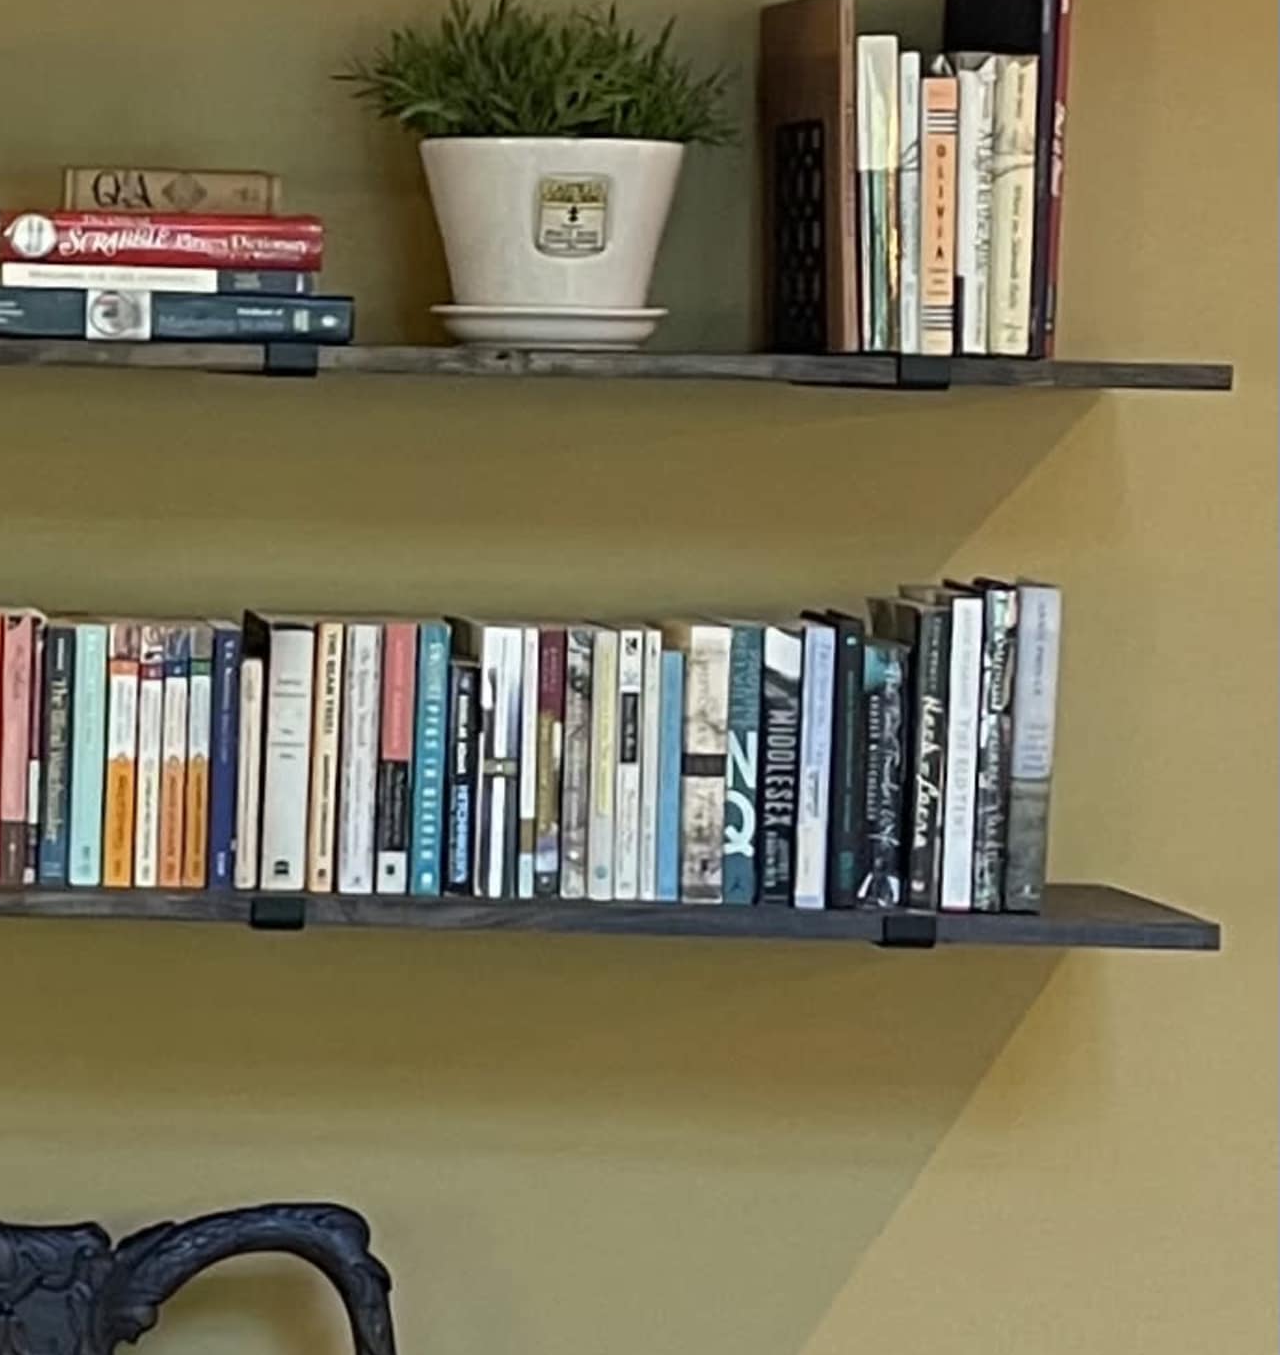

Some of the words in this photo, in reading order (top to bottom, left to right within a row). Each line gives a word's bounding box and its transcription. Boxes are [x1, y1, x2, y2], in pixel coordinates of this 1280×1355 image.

[326, 632, 338, 656] THE
[325, 659, 337, 696] BEAN
[764, 708, 795, 827] MIDDLESEX
